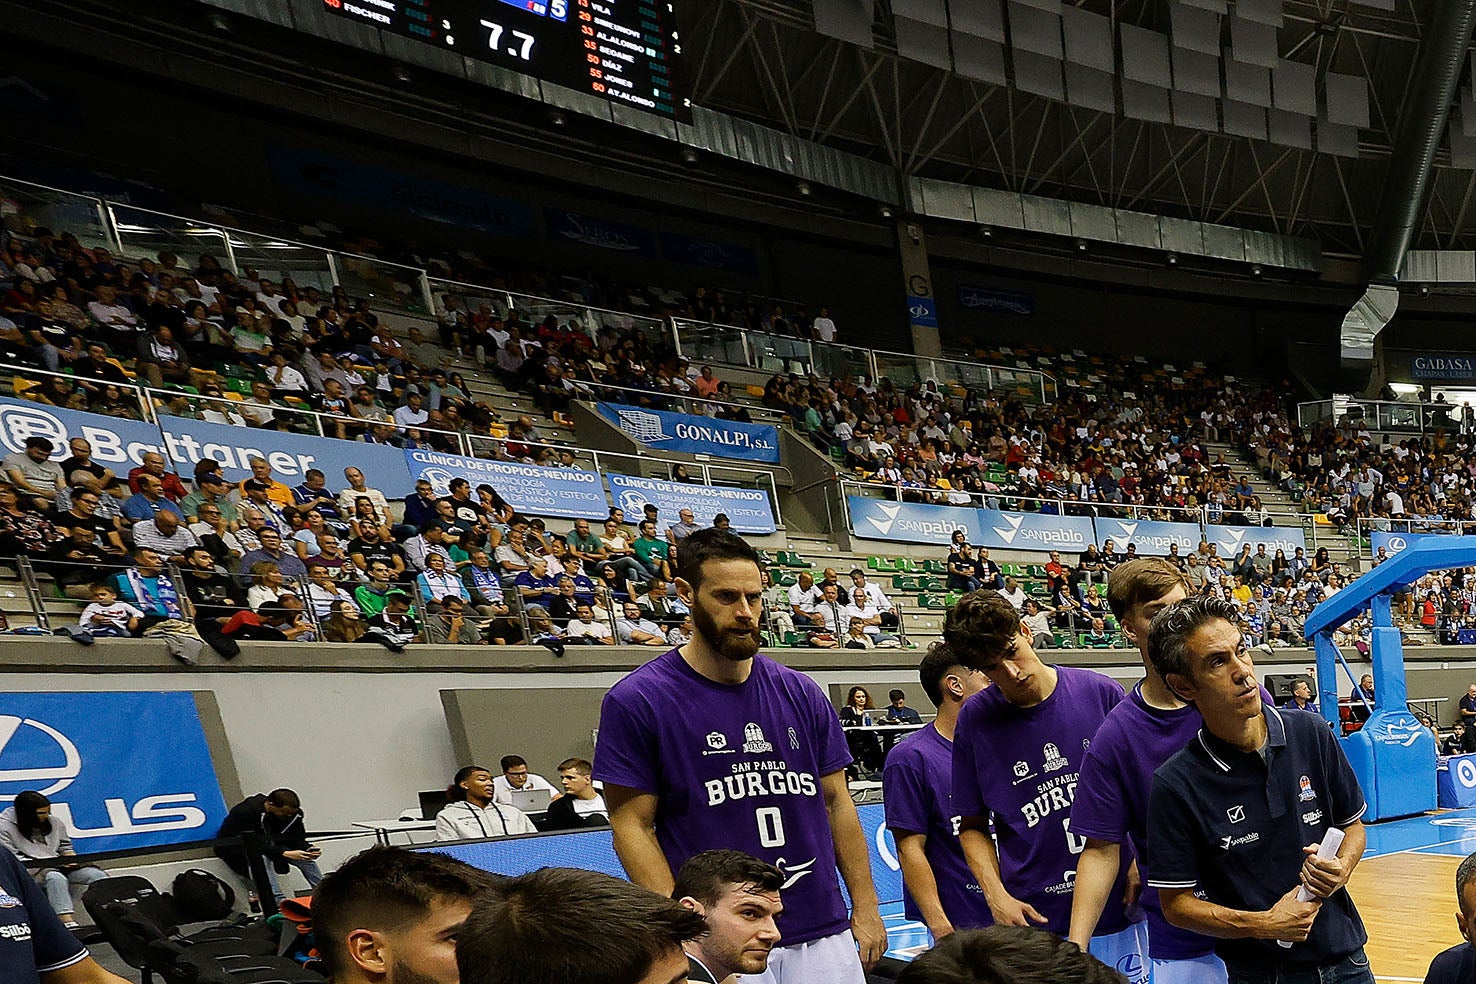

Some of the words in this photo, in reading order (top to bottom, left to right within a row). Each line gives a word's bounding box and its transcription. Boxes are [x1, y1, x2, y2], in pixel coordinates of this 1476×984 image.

[591, 2, 611, 16] VILA
[480, 19, 535, 61] 7.7
[1415, 357, 1473, 371] GABASA
[81, 426, 315, 475] Battaner
[412, 452, 465, 469] CLÍNICA
[465, 458, 482, 470] DE
[484, 460, 595, 483] PROPIOS-NEVADO
[613, 476, 656, 491] CLÍNICA
[657, 482, 672, 492] DE
[673, 483, 763, 501] PROPIOS-NEVADO
[732, 762, 751, 773] SAN
[755, 761, 786, 770] PABLO
[705, 771, 817, 806] BURGOS
[1037, 780, 1054, 794] SAN
[1055, 772, 1080, 786] PABLO
[755, 807, 785, 848] 0
